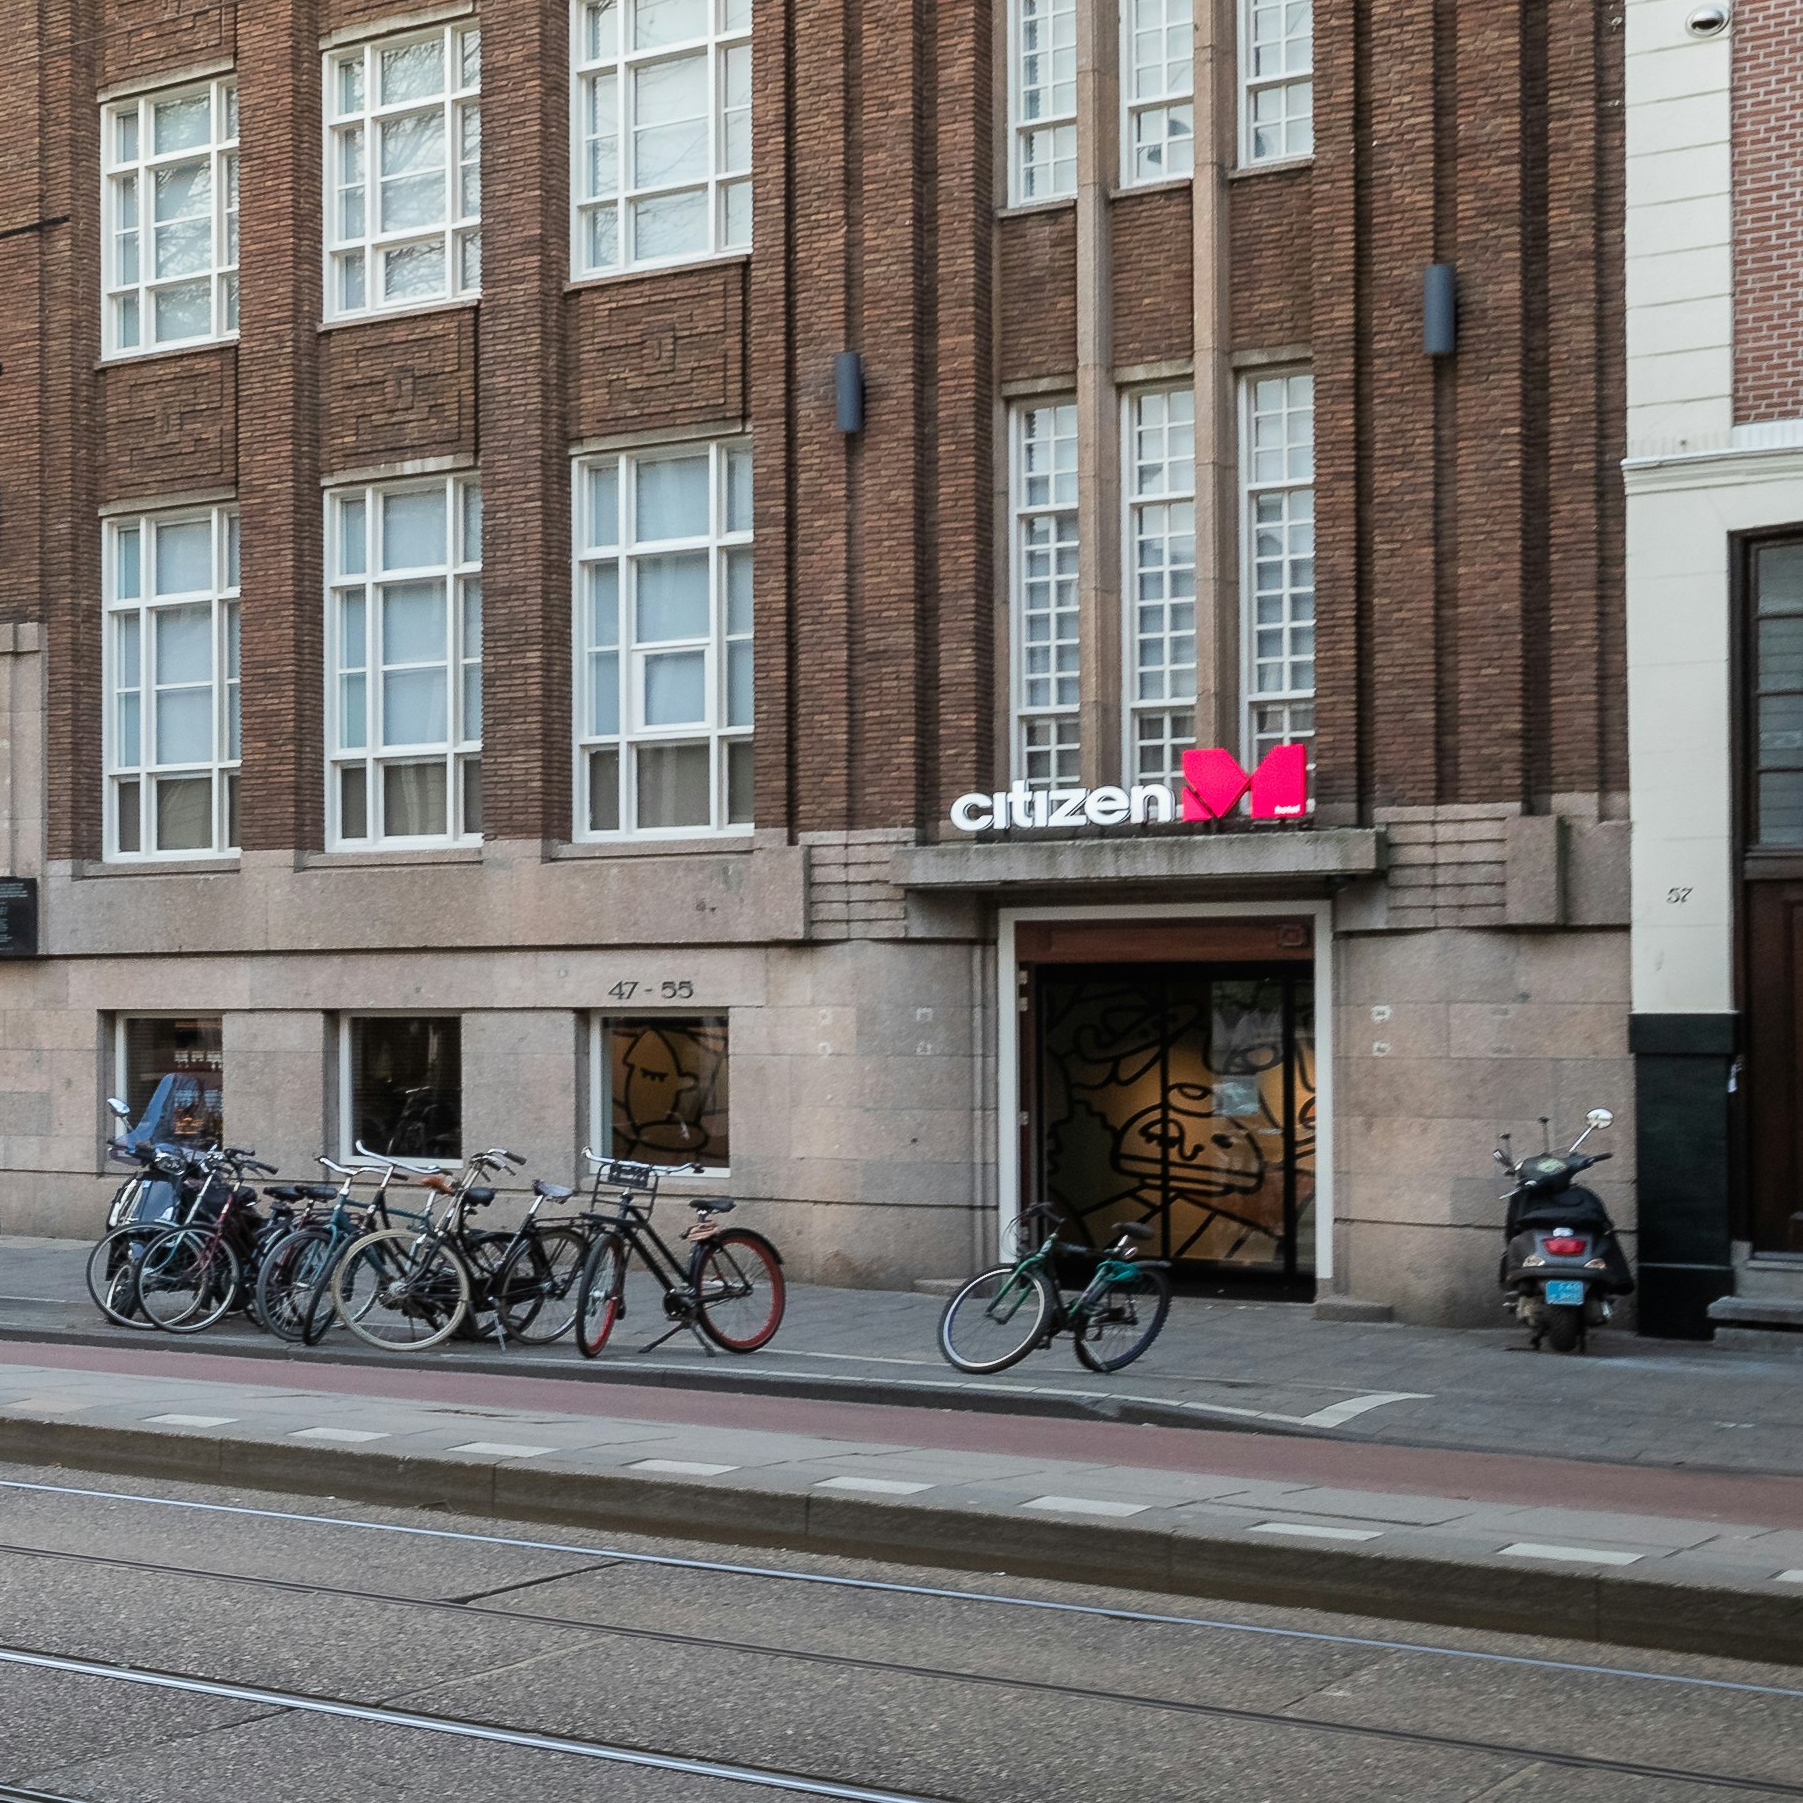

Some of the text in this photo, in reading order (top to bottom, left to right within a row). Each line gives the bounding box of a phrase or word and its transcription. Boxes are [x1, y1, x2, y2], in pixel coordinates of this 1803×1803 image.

[1666, 887, 1694, 904] 57
[608, 981, 639, 1000] 47
[661, 981, 694, 999] 55
